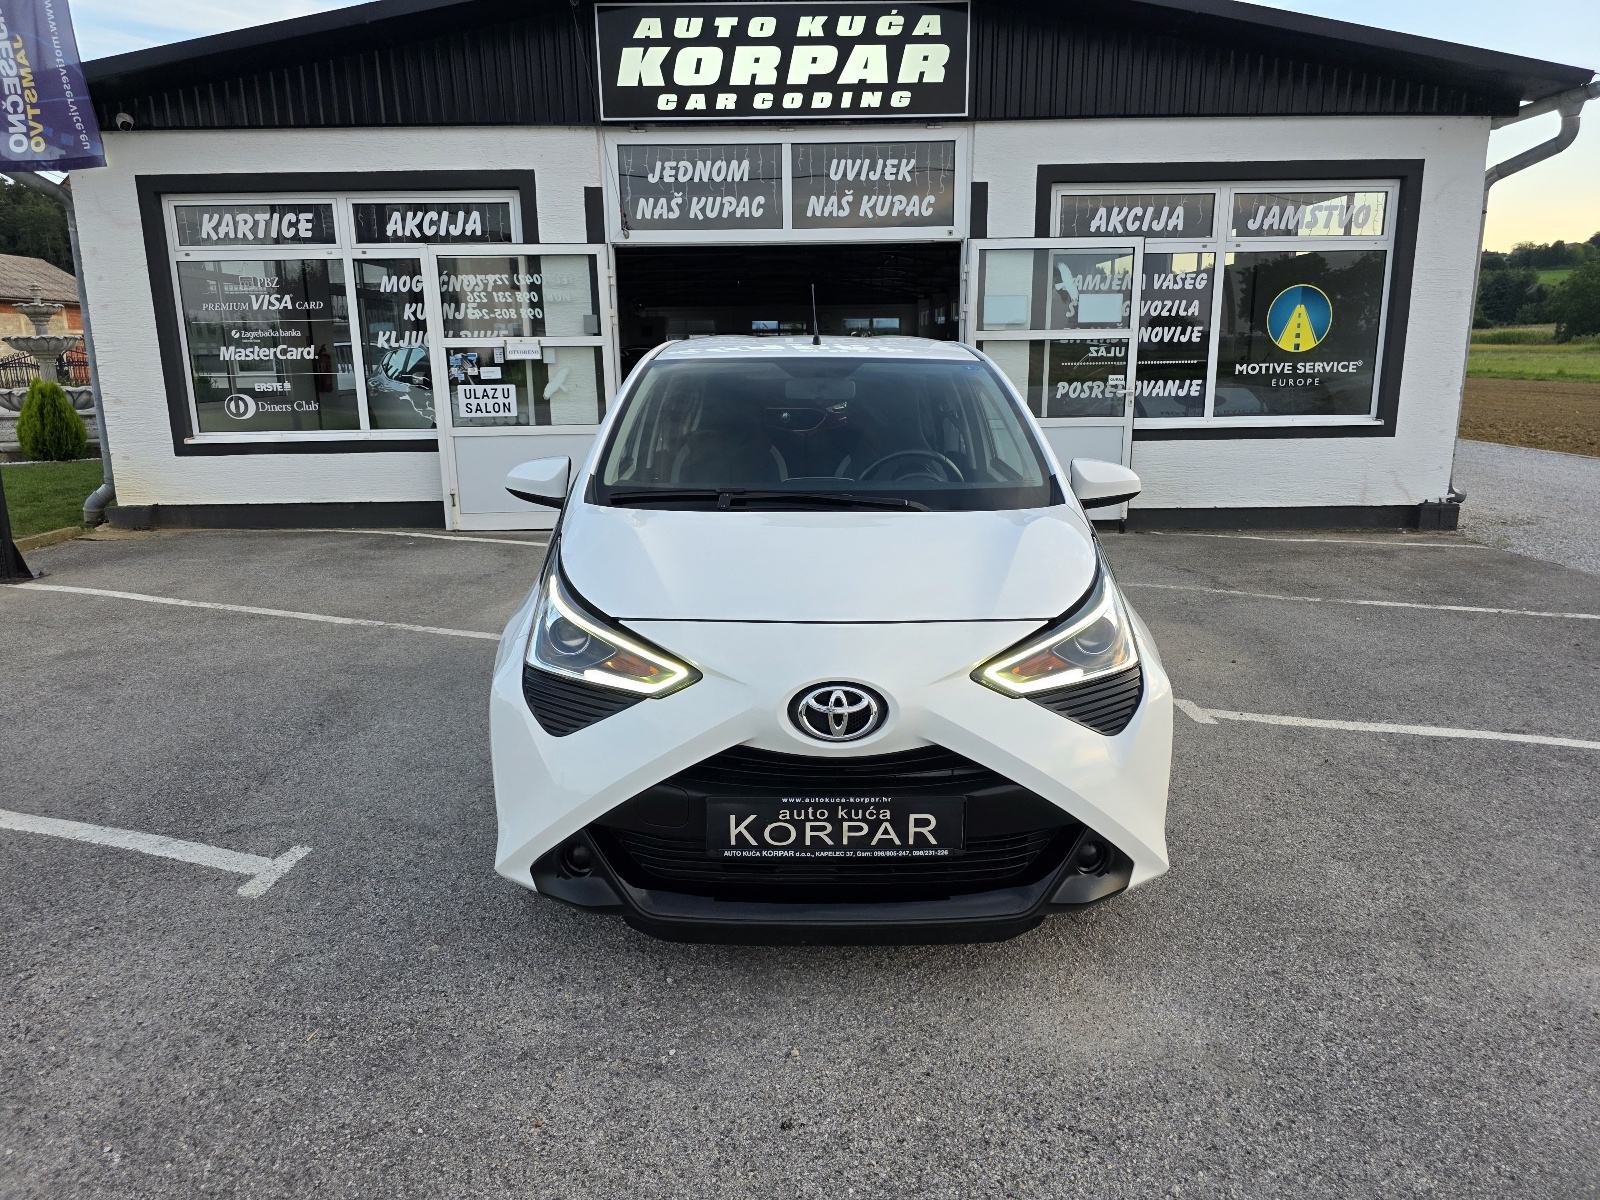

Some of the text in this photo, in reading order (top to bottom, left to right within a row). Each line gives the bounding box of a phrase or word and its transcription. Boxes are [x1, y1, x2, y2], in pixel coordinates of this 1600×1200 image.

[632, 9, 942, 39] AUTO KUĆA
[616, 43, 951, 87] KORPAR
[656, 90, 912, 111] CAR CODING
[647, 158, 750, 184] JEDNOM
[829, 158, 916, 183] UVIJEK
[636, 191, 766, 220] NAŠ KUPAC
[806, 189, 936, 220] NAŠ KUPAC
[201, 212, 313, 241] KARTICE
[386, 210, 482, 239] AKCIJA
[1089, 205, 1185, 234] AKCIJA
[1247, 204, 1372, 231] JAMSTVO
[257, 276, 280, 288] PBZ
[380, 270, 496, 293] MOGĆNOST
[1069, 273, 1146, 291] AMJEN
[202, 293, 324, 311] PREMIUM VISA CARD
[403, 302, 478, 322] KUNJE
[1139, 299, 1200, 317] VOZILA
[240, 328, 302, 339] Zagrebačka banka
[1138, 326, 1204, 344] NOVIJE
[1234, 362, 1293, 375] MOTIVE
[254, 382, 284, 392] ERSTE
[1271, 377, 1320, 387] EUROPE
[463, 387, 511, 400] ULAZ U
[257, 400, 320, 412] Diners Club
[465, 401, 511, 414] SALON
[778, 805, 891, 820] auto kuća
[729, 813, 938, 846] KORPAR
